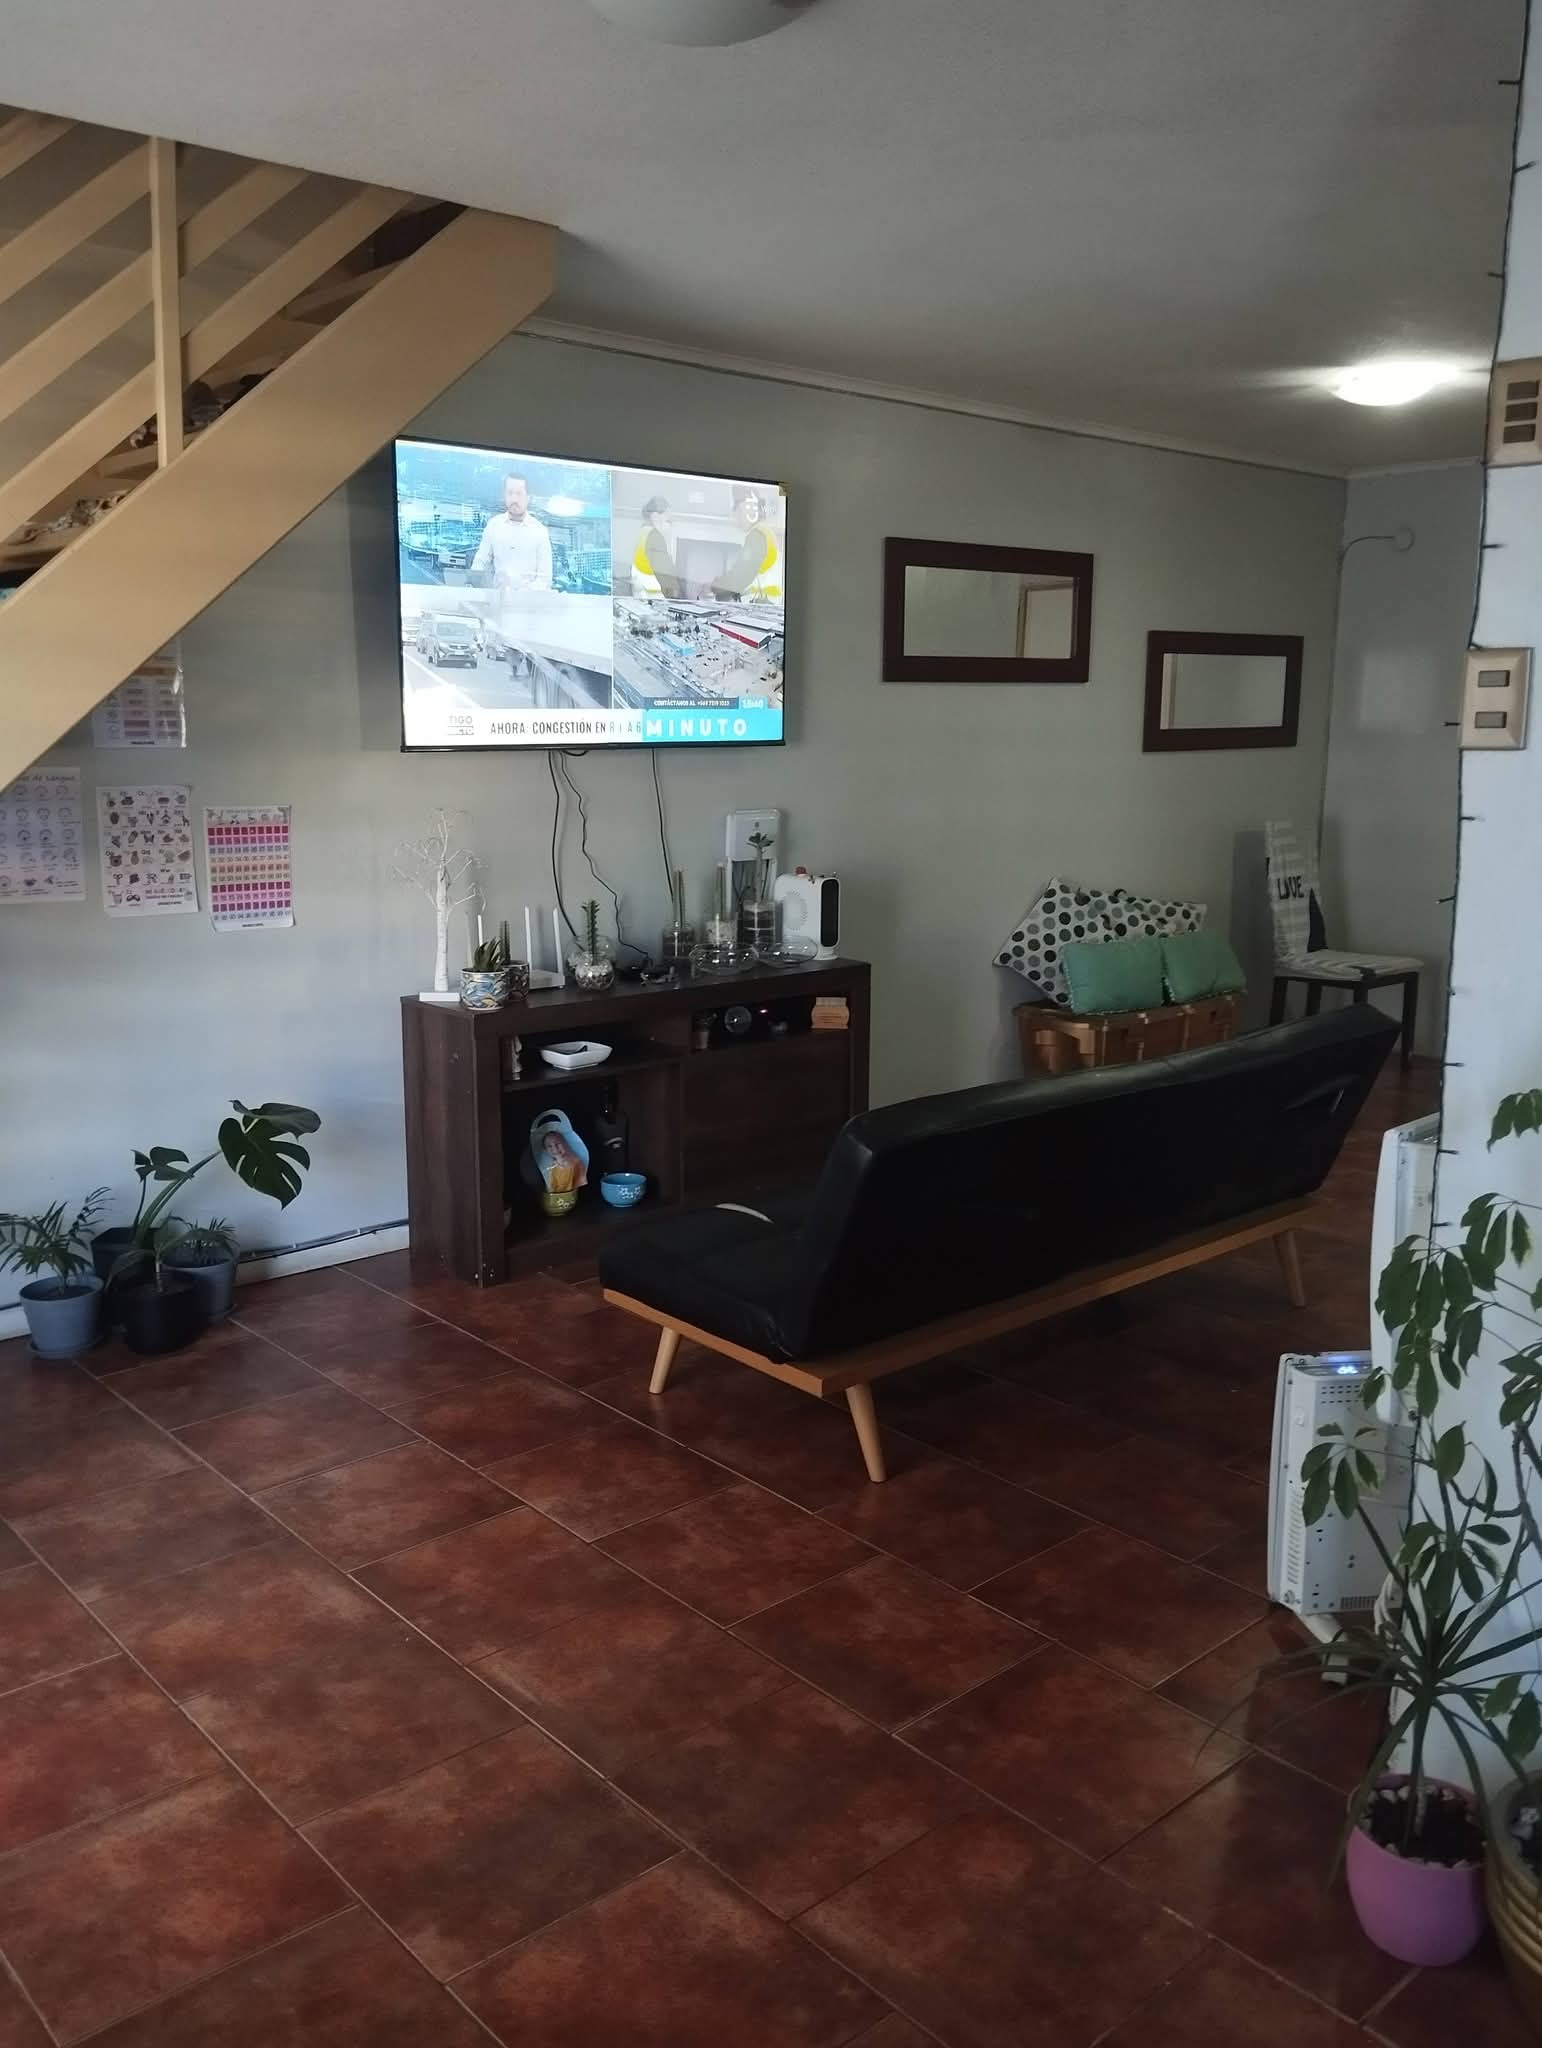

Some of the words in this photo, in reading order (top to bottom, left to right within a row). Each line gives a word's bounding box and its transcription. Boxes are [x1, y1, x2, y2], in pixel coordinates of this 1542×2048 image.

[490, 721, 529, 735] AHORA:
[532, 716, 592, 735] CONGESTIÓN
[595, 721, 606, 734] EN
[646, 718, 747, 737] MINUTO
